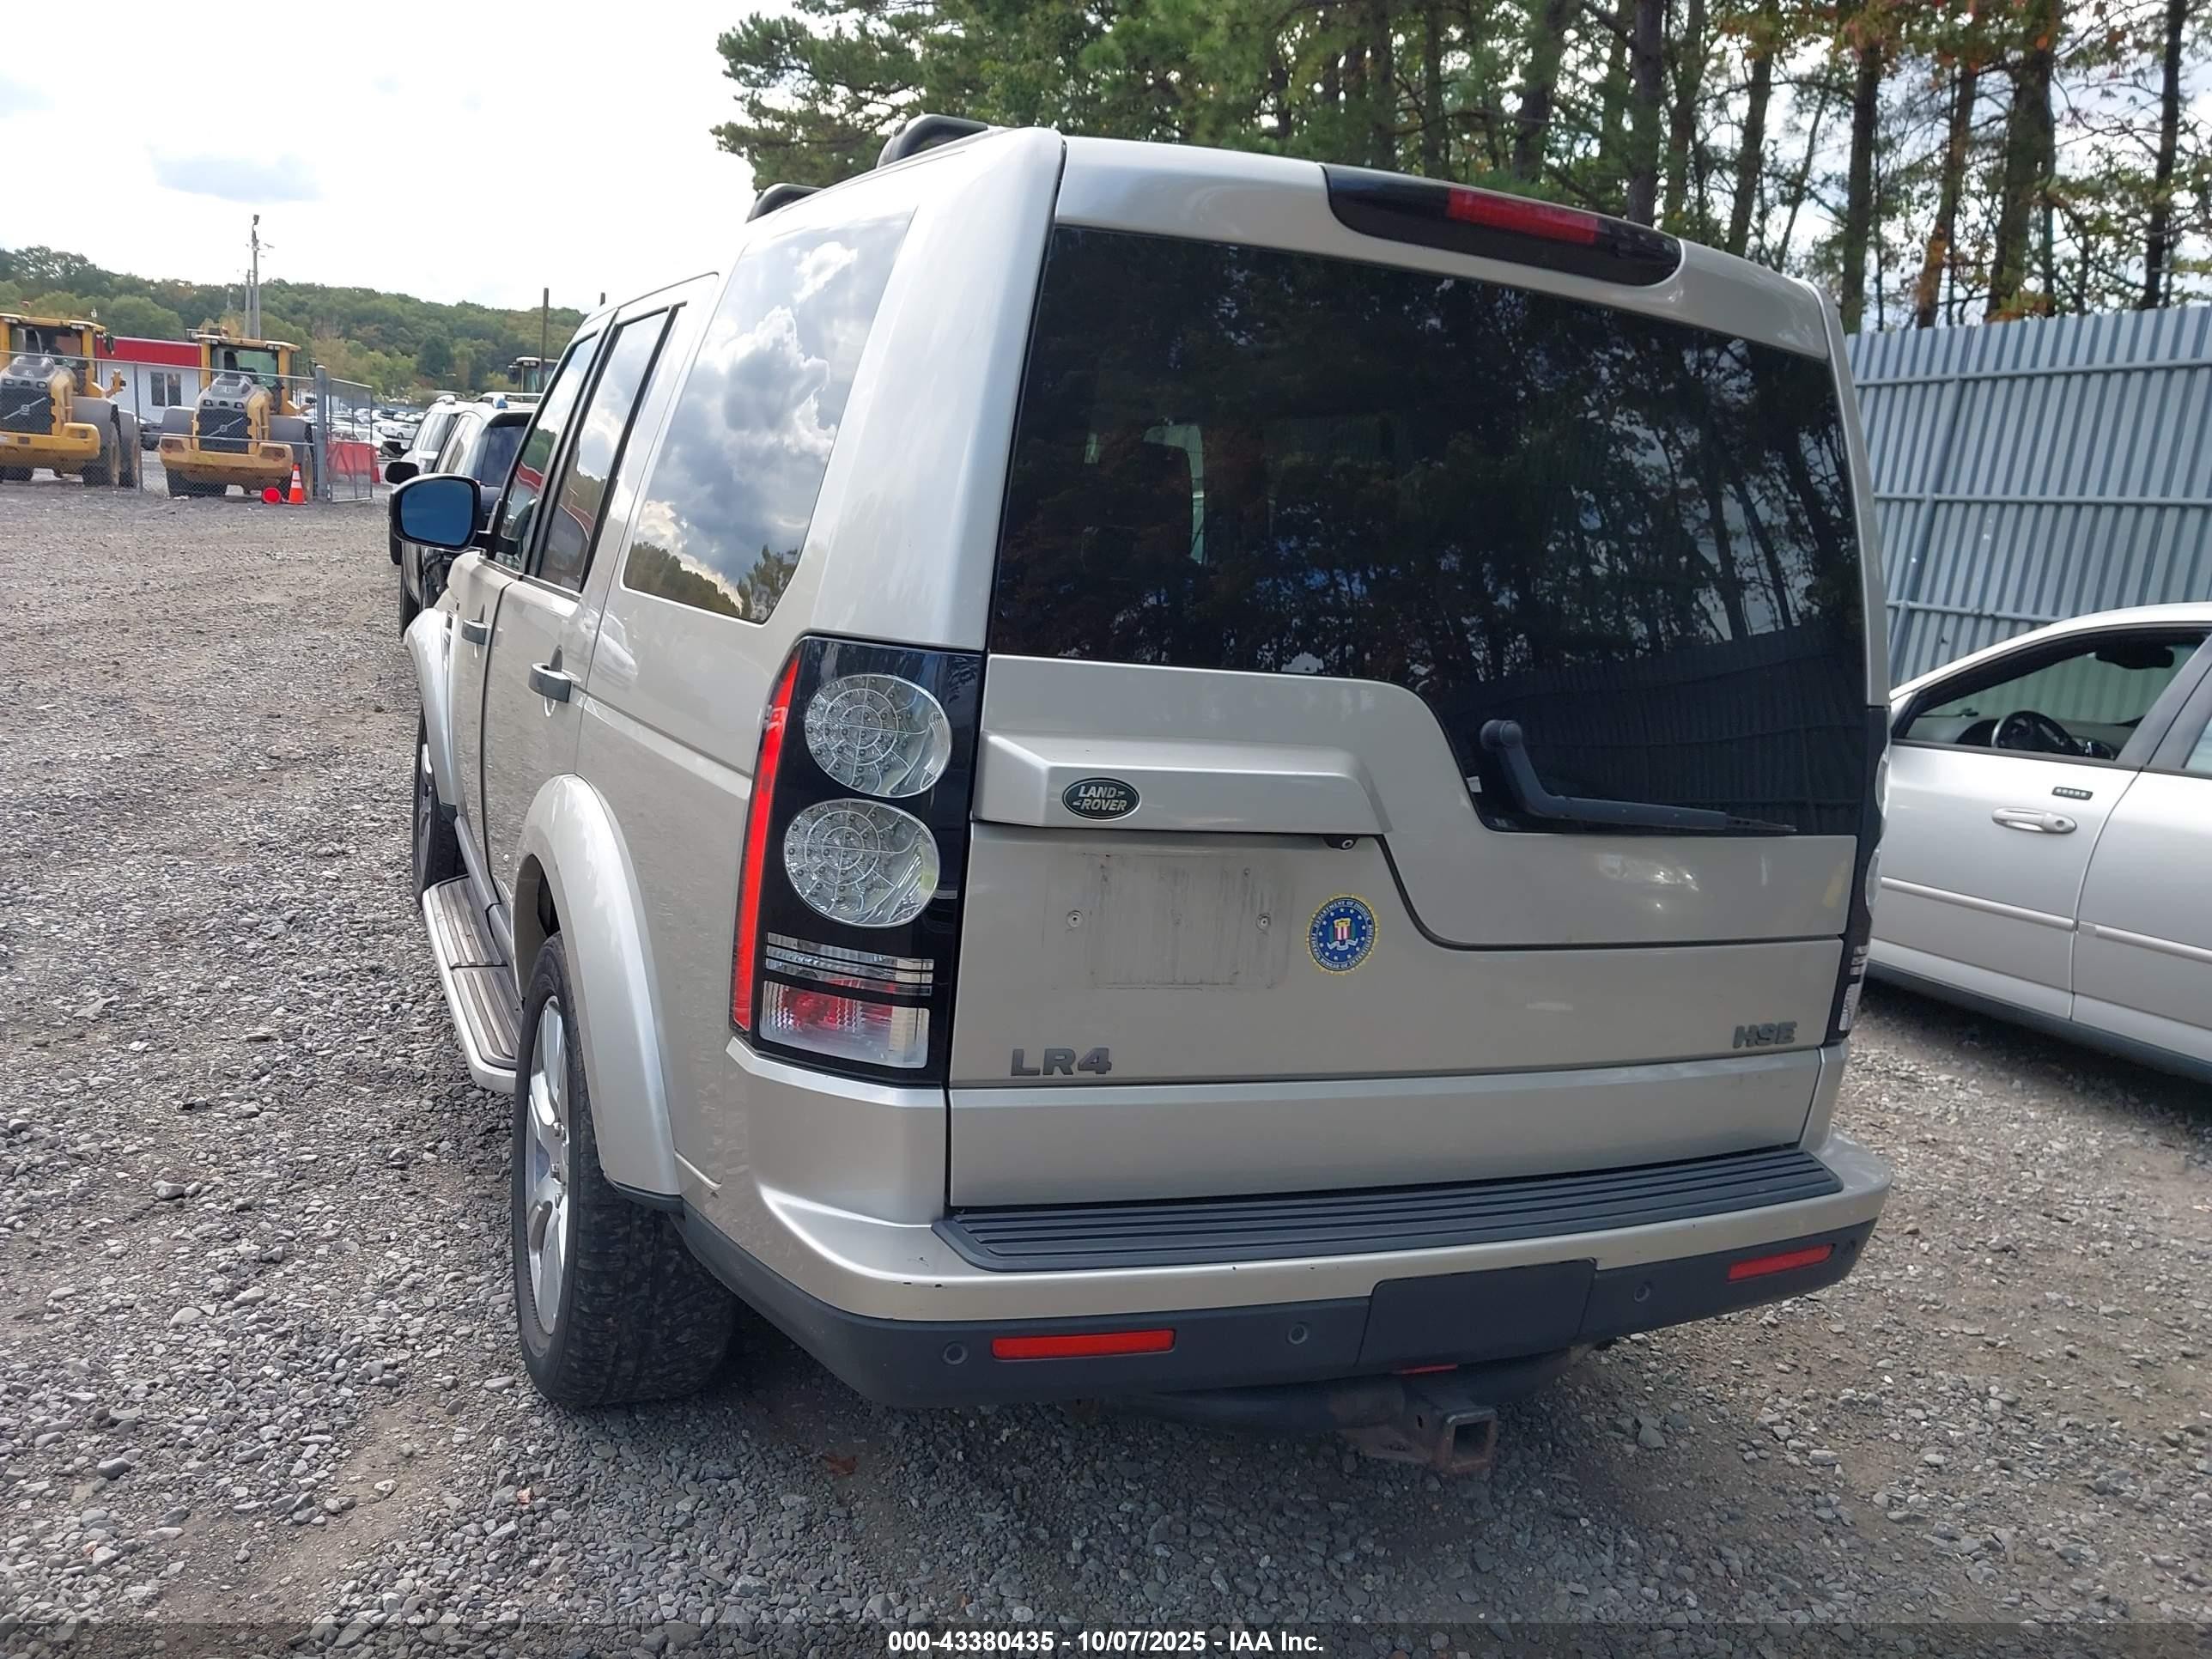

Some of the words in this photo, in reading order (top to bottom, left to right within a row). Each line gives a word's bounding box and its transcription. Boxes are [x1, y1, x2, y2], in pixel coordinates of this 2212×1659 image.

[1078, 785, 1117, 798] LAND
[1080, 799, 1127, 811] ROVER
[1732, 1021, 1798, 1048] HSE
[1011, 1047, 1112, 1076] LR4
